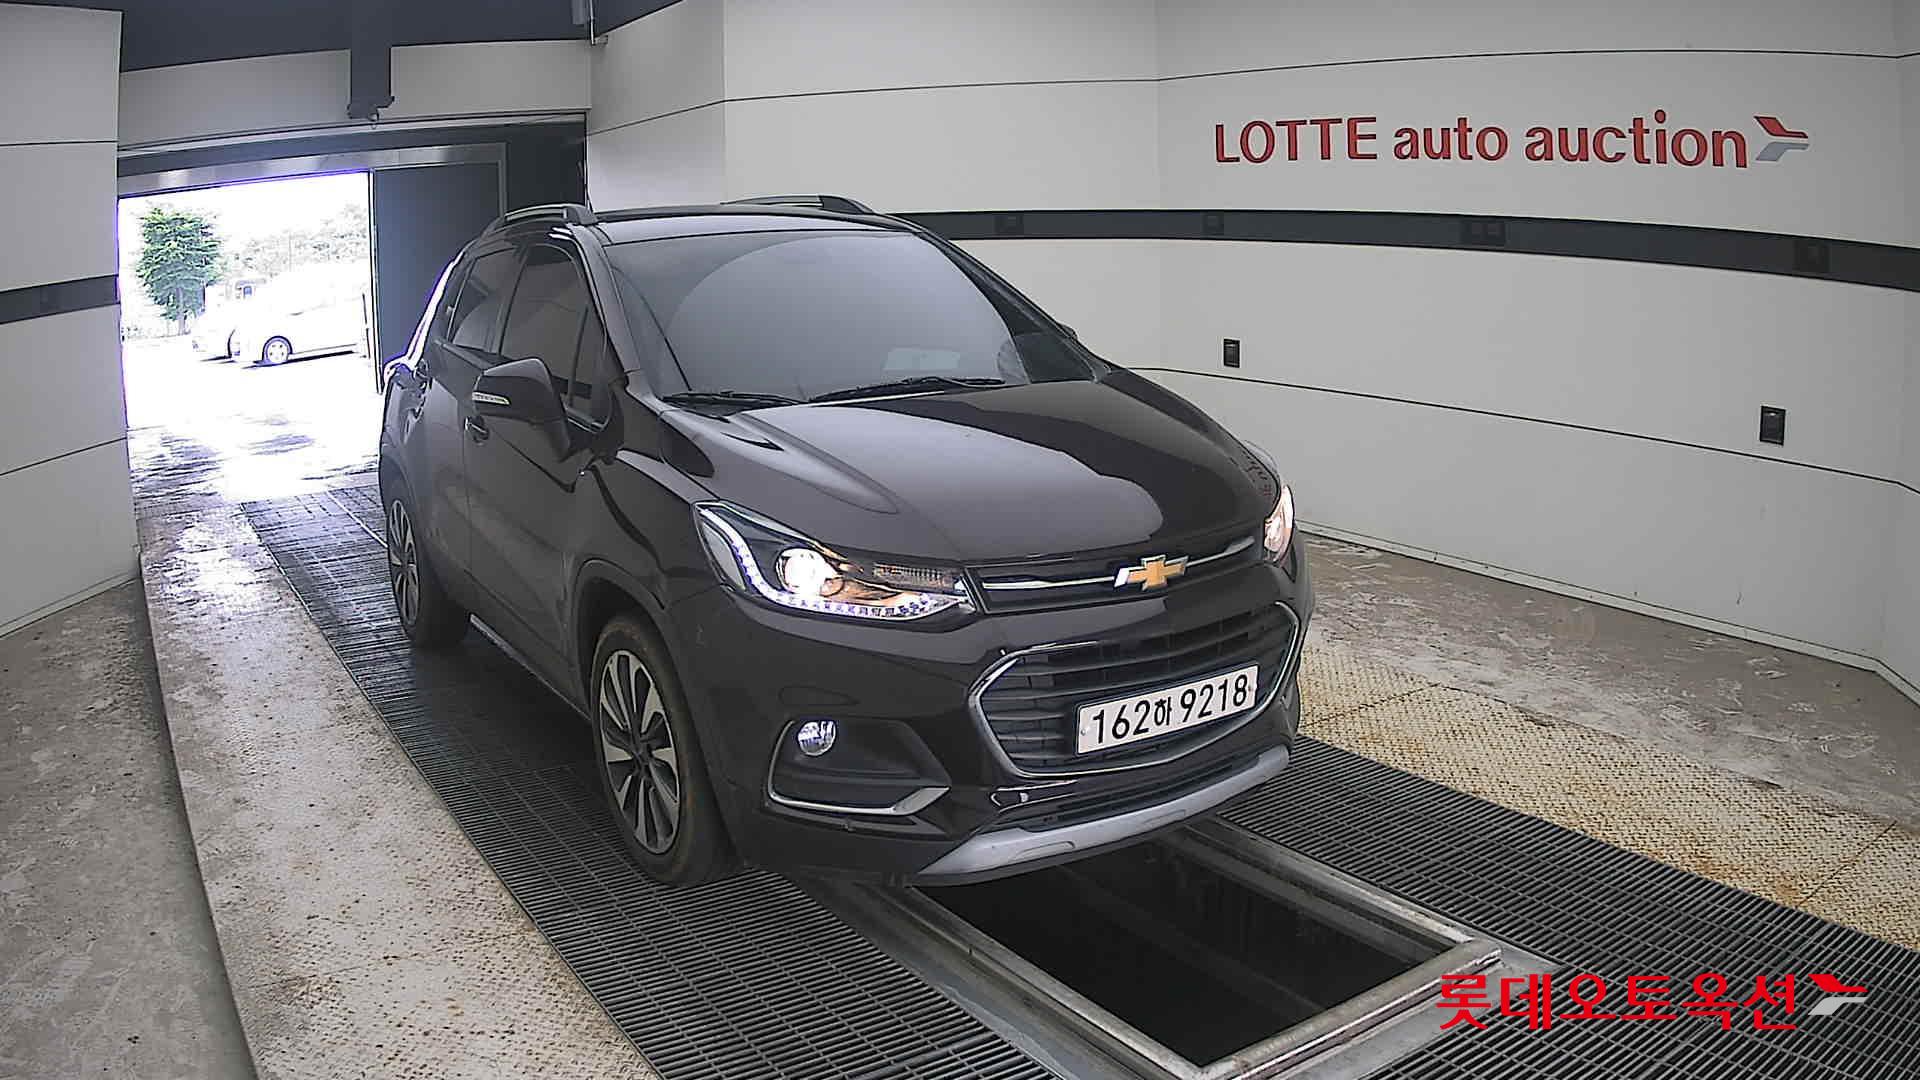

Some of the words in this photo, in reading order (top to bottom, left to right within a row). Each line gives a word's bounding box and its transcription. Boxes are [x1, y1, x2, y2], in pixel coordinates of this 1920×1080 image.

[1215, 117, 1377, 163] LOTTE
[1393, 117, 1509, 161] auto
[1524, 109, 1749, 168] auction
[1180, 674, 1249, 723] 9218
